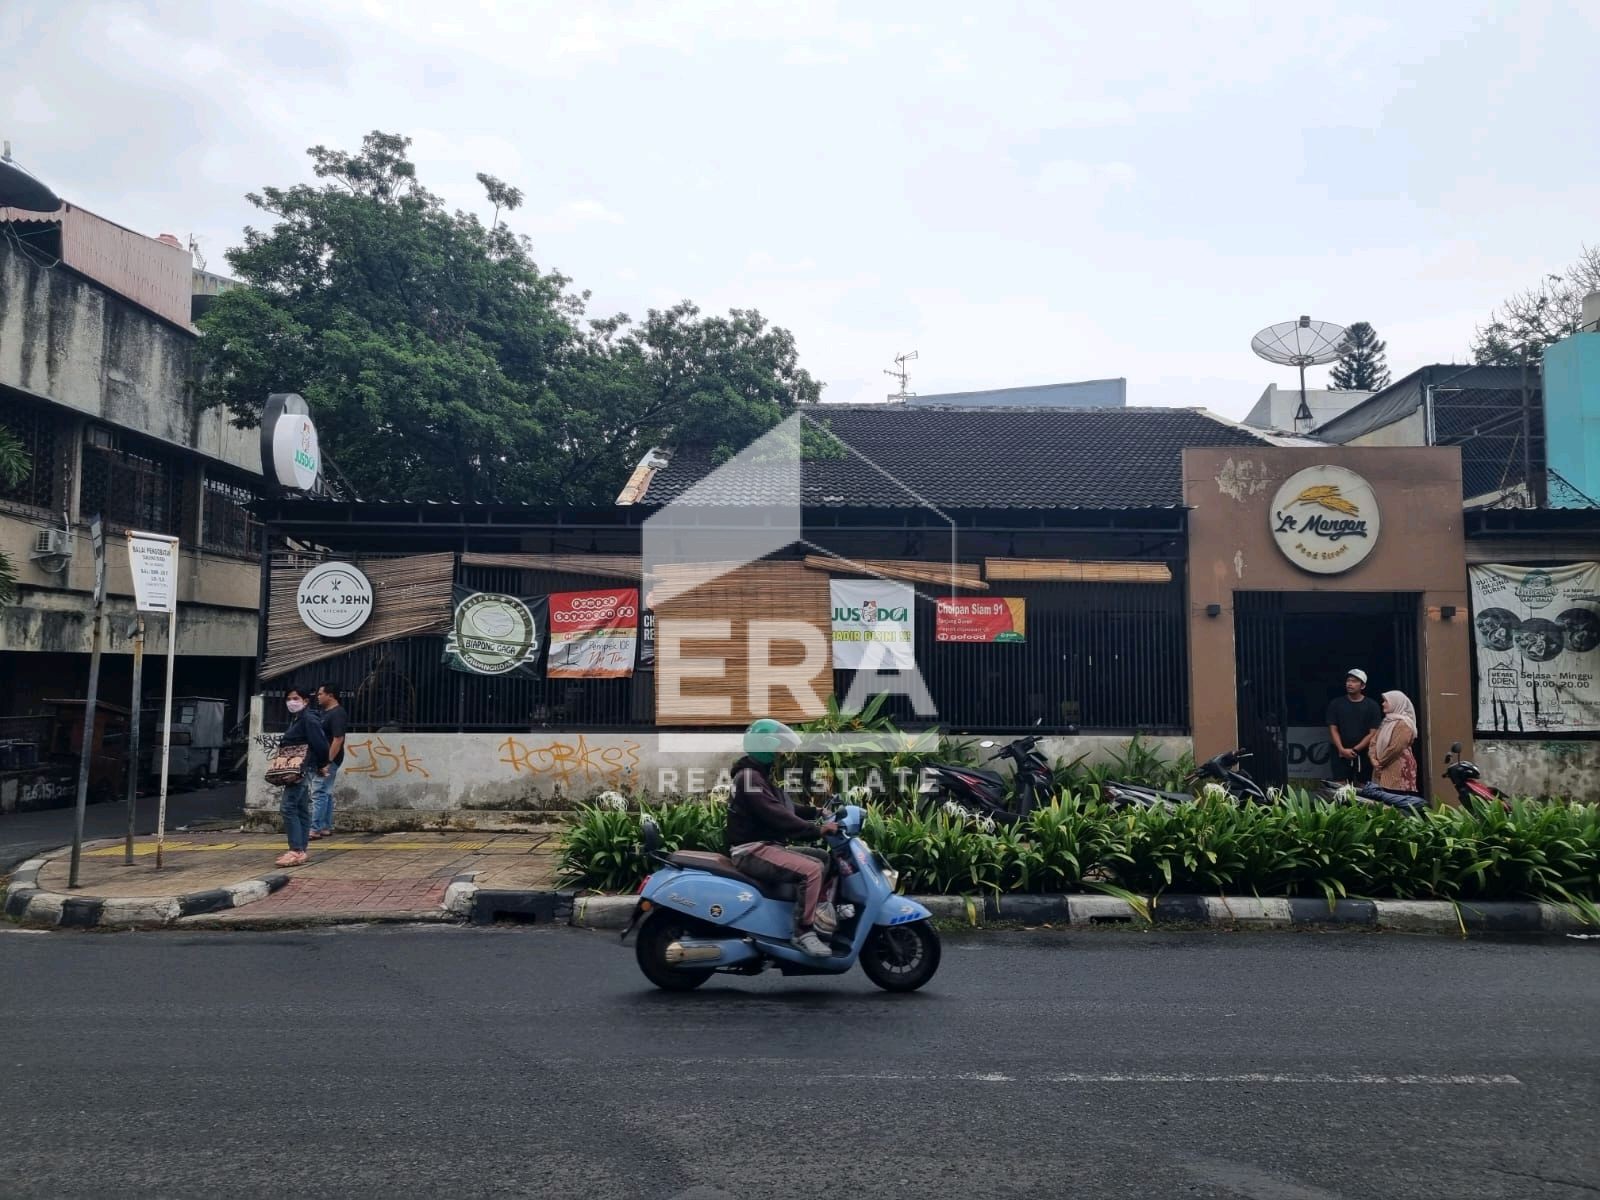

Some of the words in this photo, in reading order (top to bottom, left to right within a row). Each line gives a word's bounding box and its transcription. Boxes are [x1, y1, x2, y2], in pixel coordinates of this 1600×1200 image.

[1275, 511, 1297, 533] Le
[1298, 514, 1367, 541] Mangan
[300, 595, 328, 605] JACK
[340, 595, 370, 605] JOHN
[971, 603, 991, 615] Siam
[993, 604, 1003, 615] 91
[465, 639, 494, 651] BIAPONG
[496, 644, 516, 655] GAGA
[1520, 671, 1551, 679] Selasa
[1559, 672, 1593, 681] Minggu
